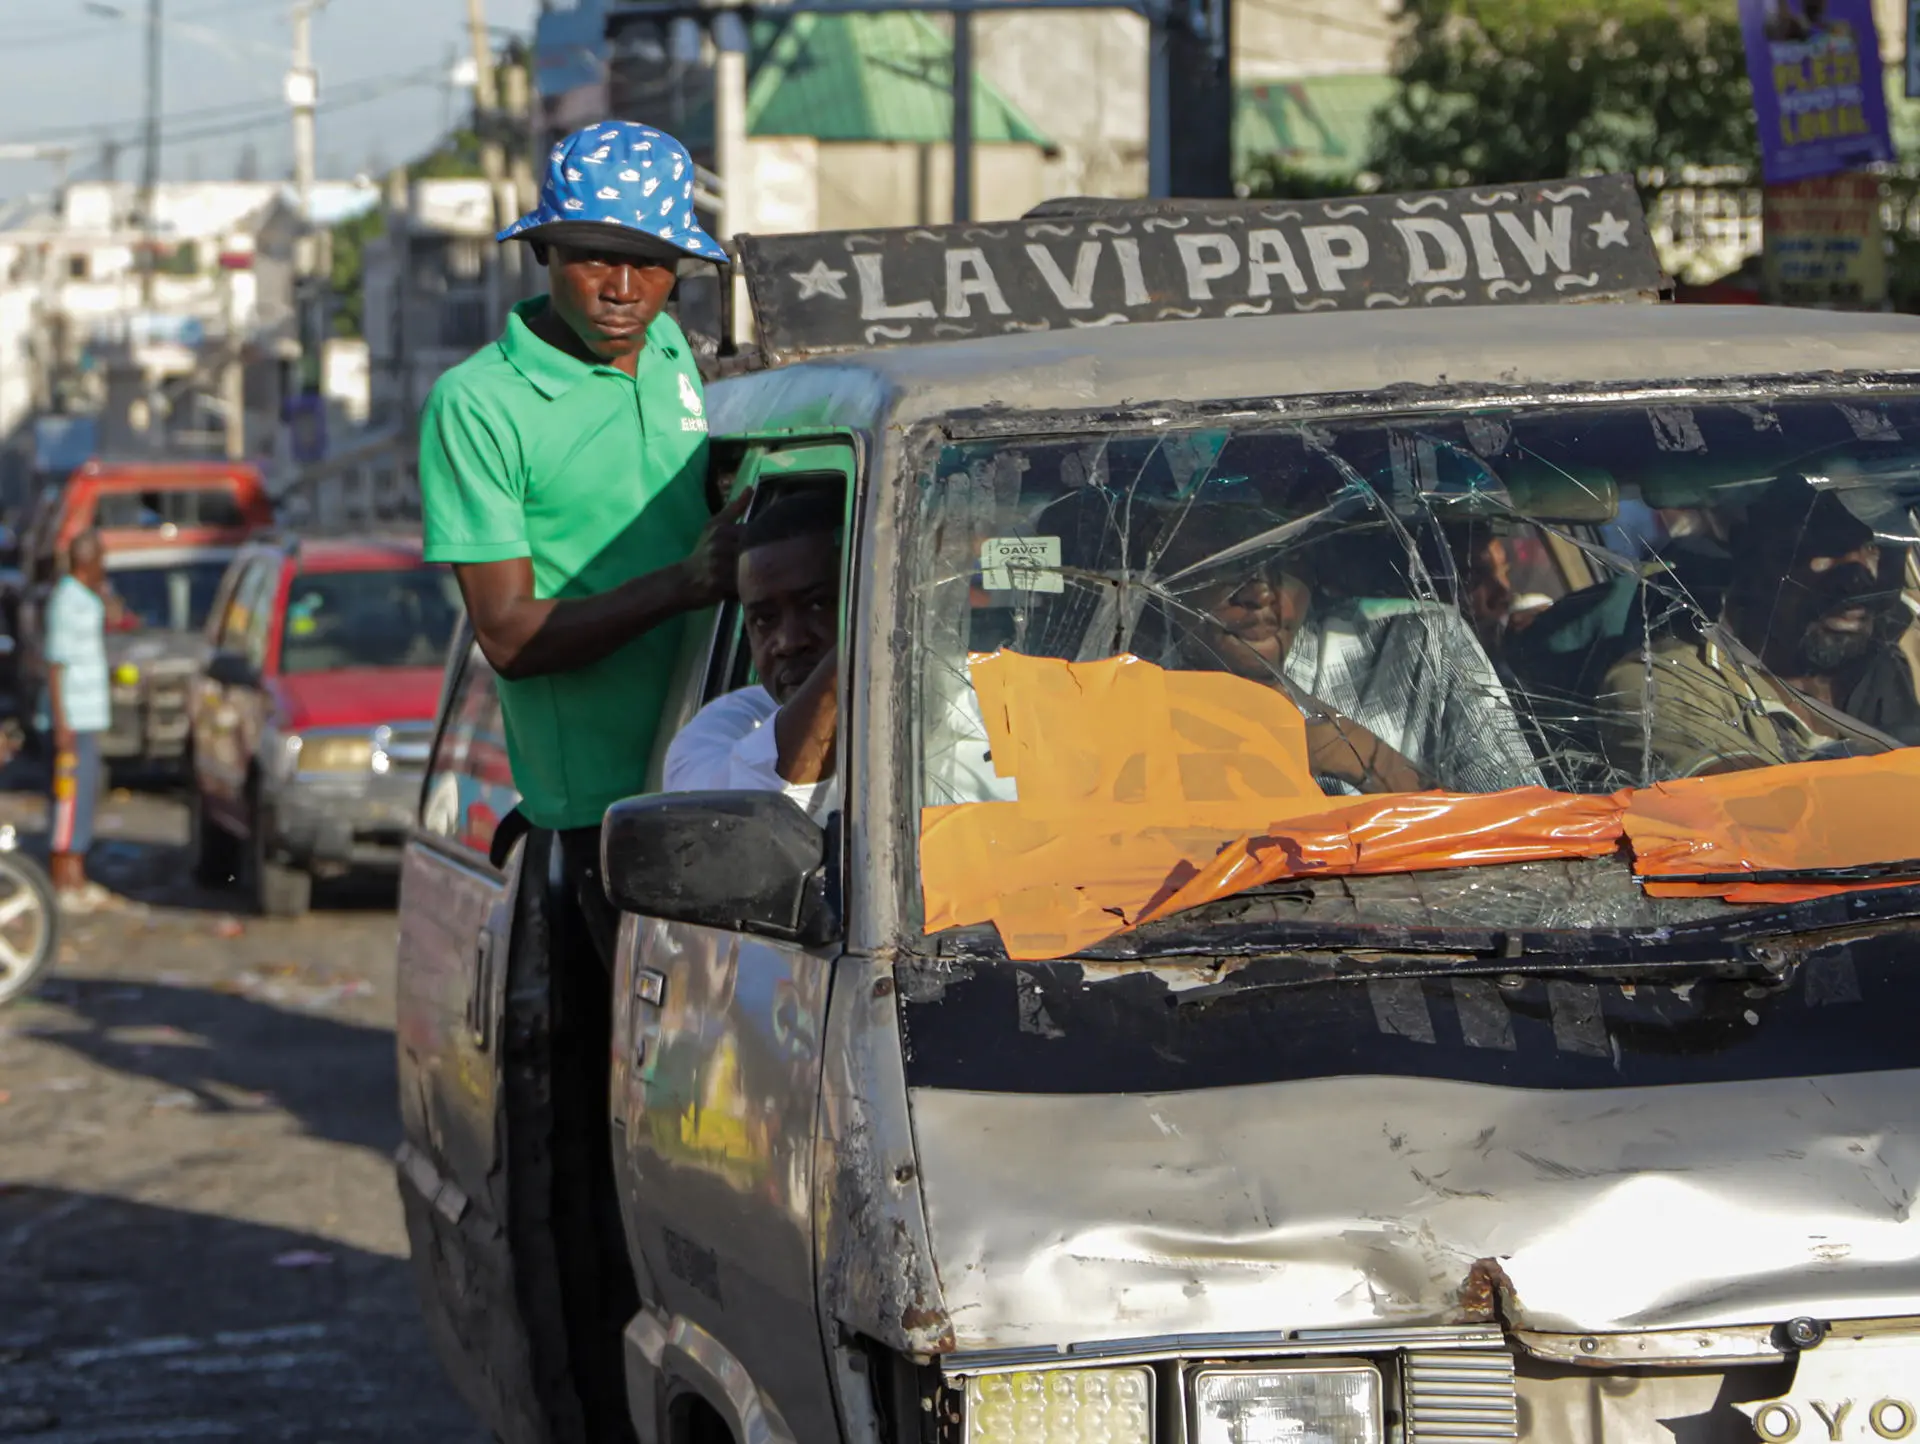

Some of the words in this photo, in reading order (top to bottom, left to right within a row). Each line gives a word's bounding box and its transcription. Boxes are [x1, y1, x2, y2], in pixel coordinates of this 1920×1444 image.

[1174, 224, 1369, 300] PAP
[1392, 205, 1573, 286] DIW
[1000, 546, 1047, 555] OAVCT
